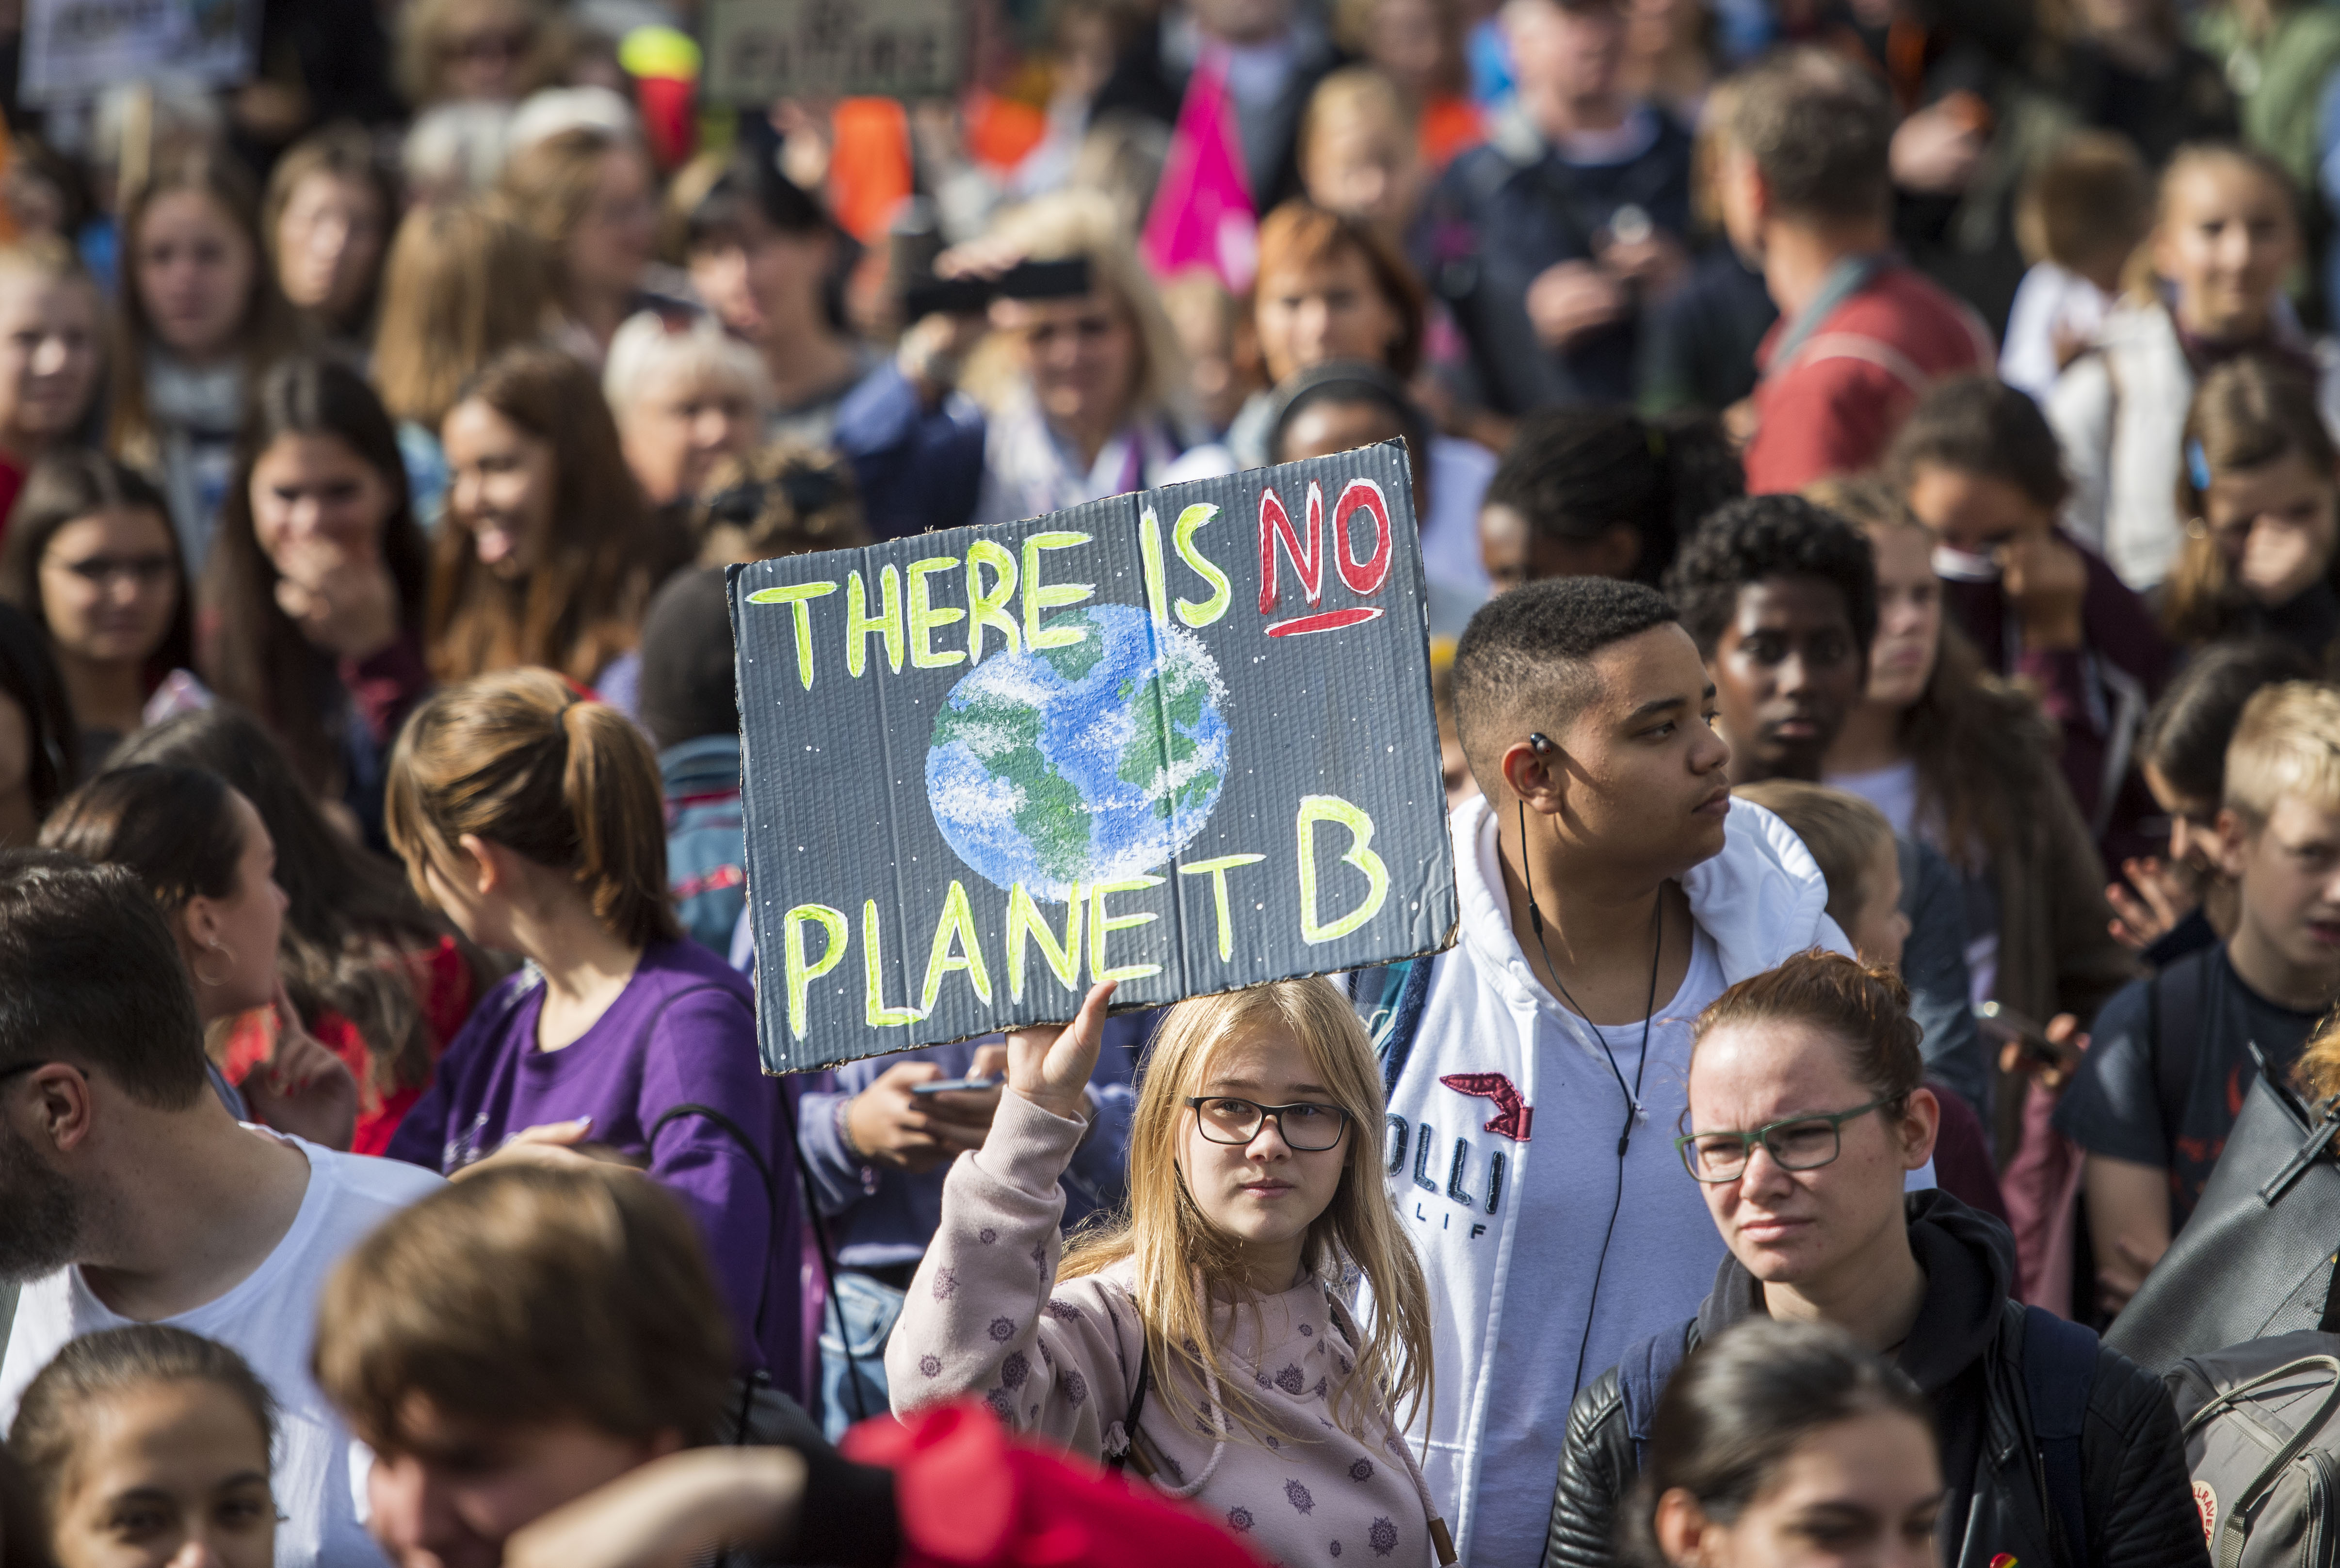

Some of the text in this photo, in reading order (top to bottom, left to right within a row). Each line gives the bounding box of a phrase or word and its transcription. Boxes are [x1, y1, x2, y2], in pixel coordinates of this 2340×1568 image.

[745, 478, 1393, 691] THERE IS NO
[783, 795, 1390, 1041] PLANET B
